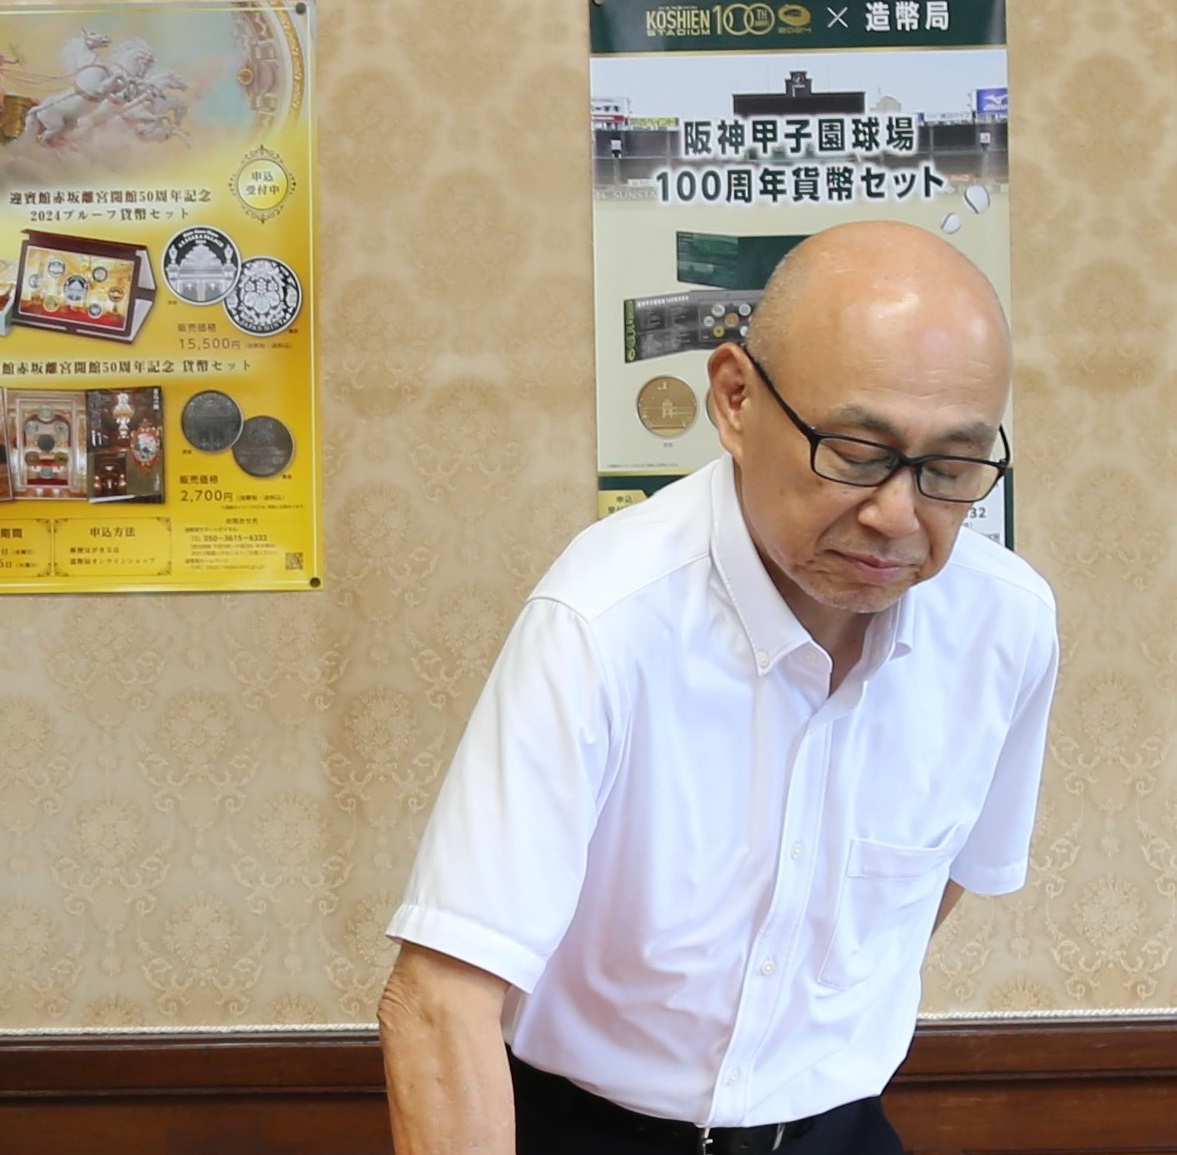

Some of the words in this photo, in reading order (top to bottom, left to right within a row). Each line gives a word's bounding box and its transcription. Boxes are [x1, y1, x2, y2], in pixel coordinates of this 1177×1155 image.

[646, 9, 711, 30] KOSHIEN
[865, 1, 950, 33] 造幣局
[684, 116, 915, 155] 阪神甲子園球場
[251, 171, 274, 182] 申込
[245, 184, 280, 196] 受付中
[656, 165, 945, 203] 100周年貨幣セット
[9, 189, 212, 205] 迎賓館赤坂離宮開館50周年記念
[30, 208, 190, 221] 2024プルーフ貨幣セット
[179, 338, 241, 350] 15,500円
[182, 359, 251, 372] 貨幣セット
[180, 490, 233, 502] 2,700円
[89, 526, 136, 537] 申込方法
